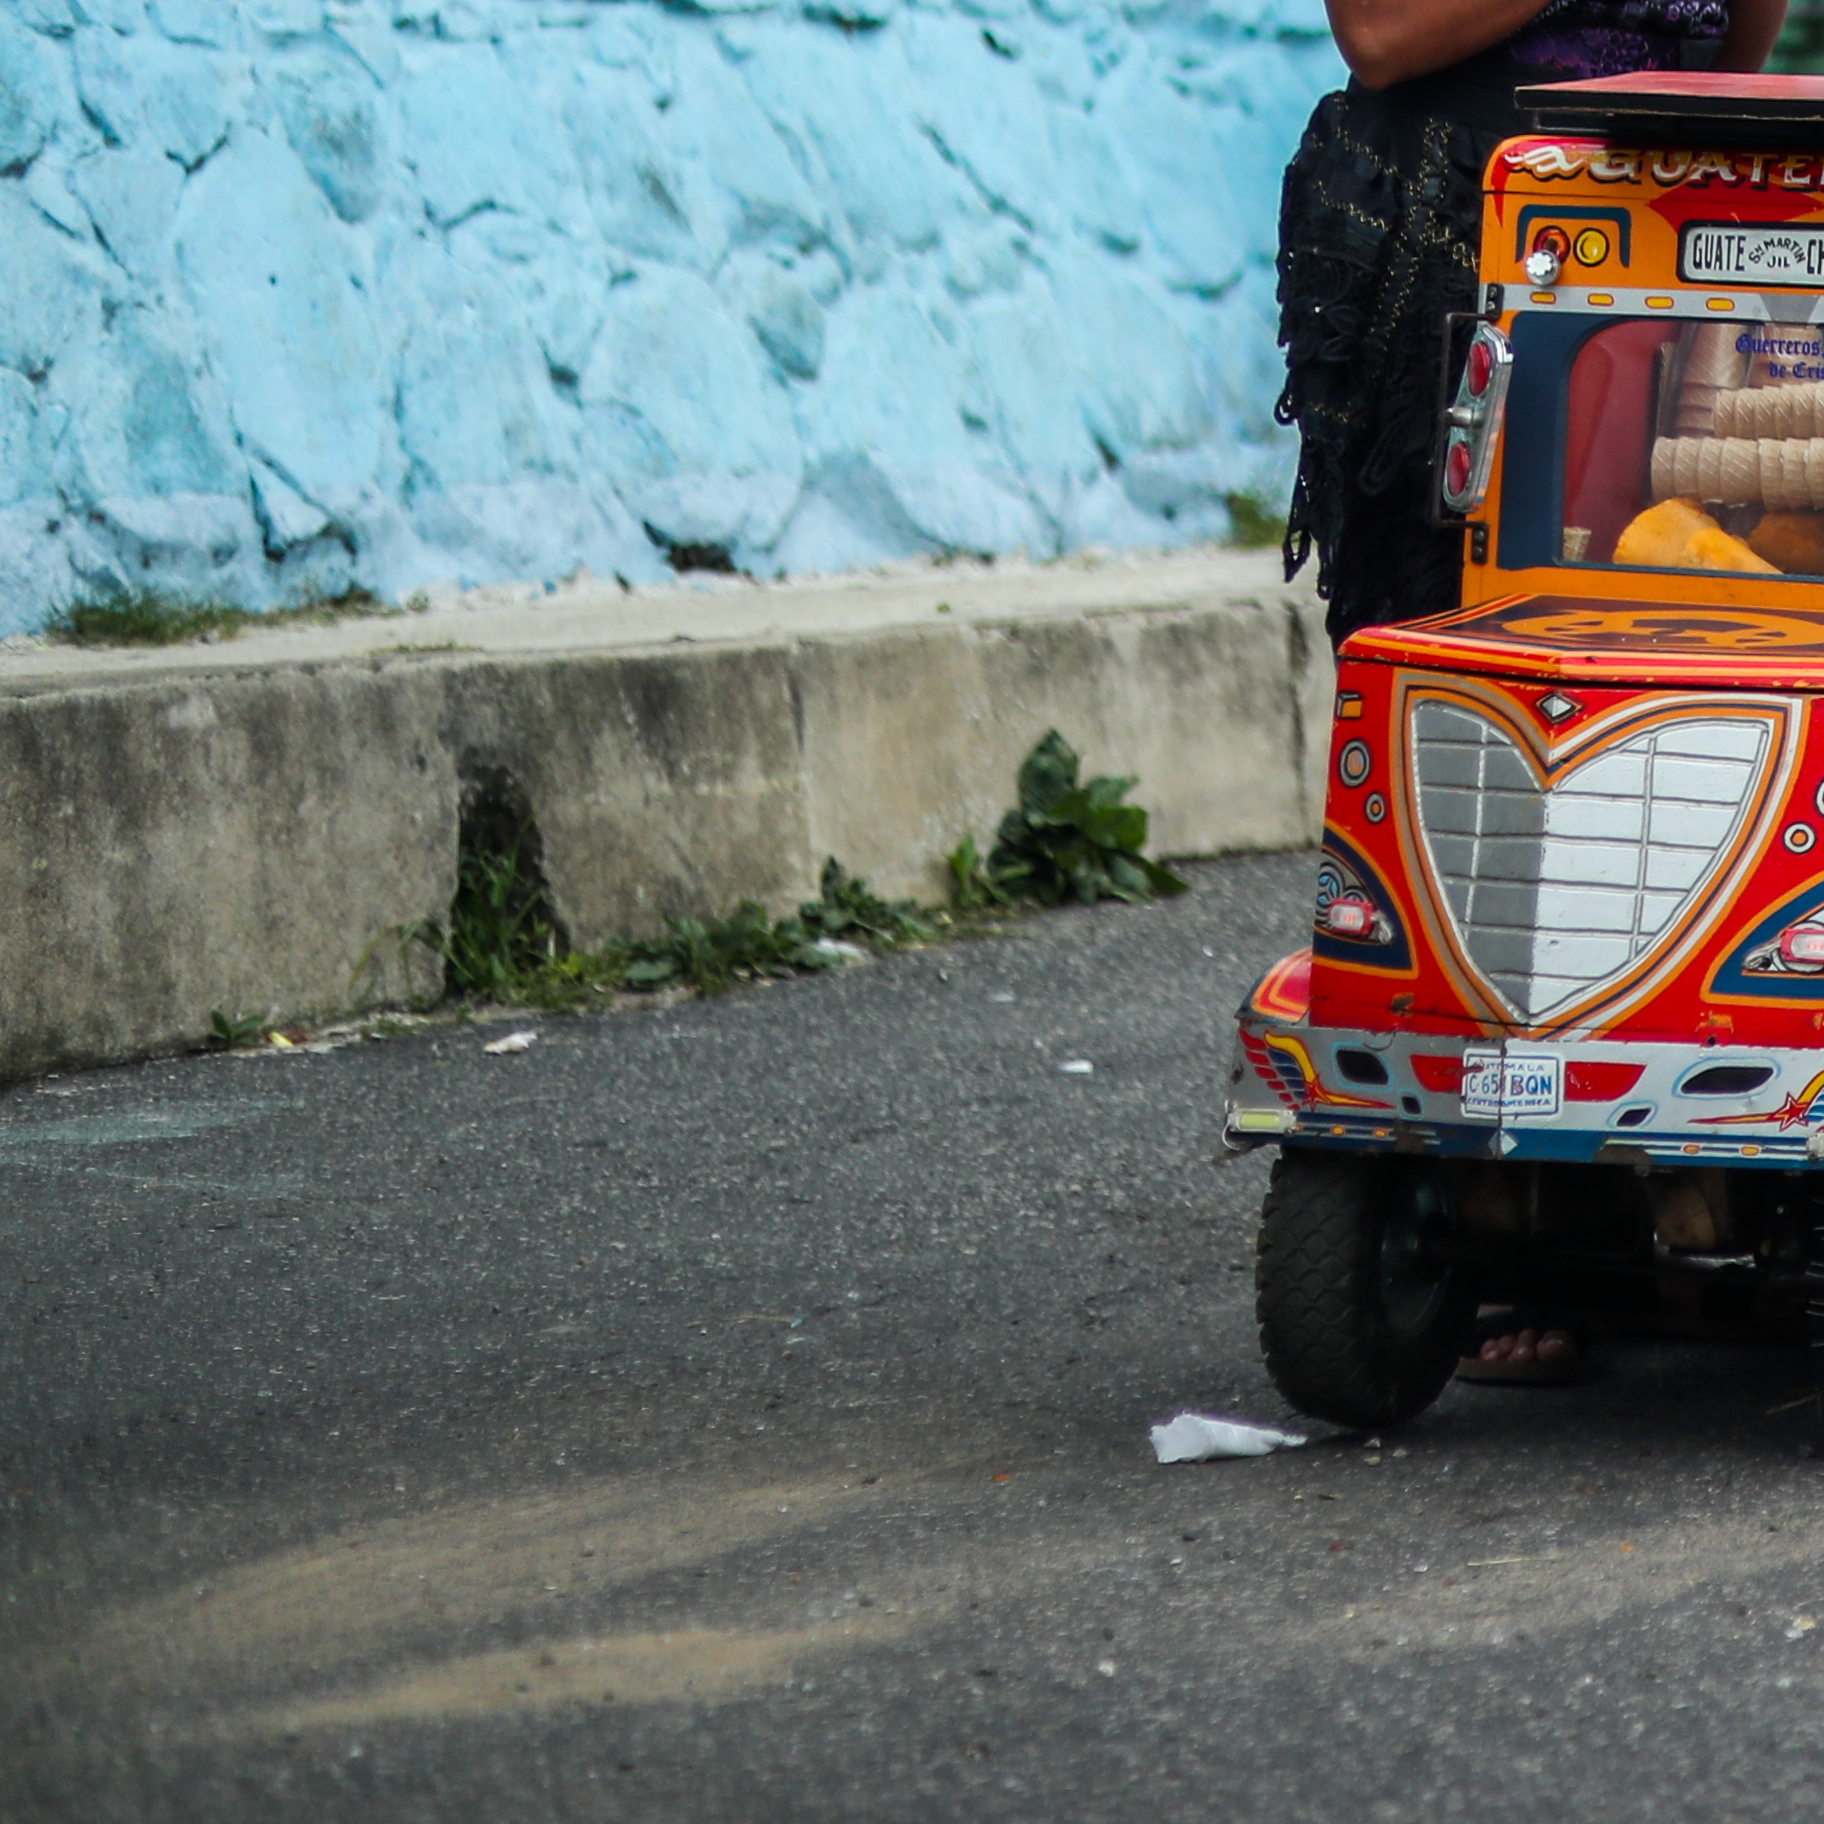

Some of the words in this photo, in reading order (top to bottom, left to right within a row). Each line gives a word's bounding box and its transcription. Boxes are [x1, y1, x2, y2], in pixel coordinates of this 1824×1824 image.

[1692, 232, 1747, 273] GUATE
[1763, 236, 1807, 264] MARTIN
[1767, 255, 1791, 269] JIL
[1735, 333, 1821, 356] Guerreros
[1769, 361, 1787, 378] de
